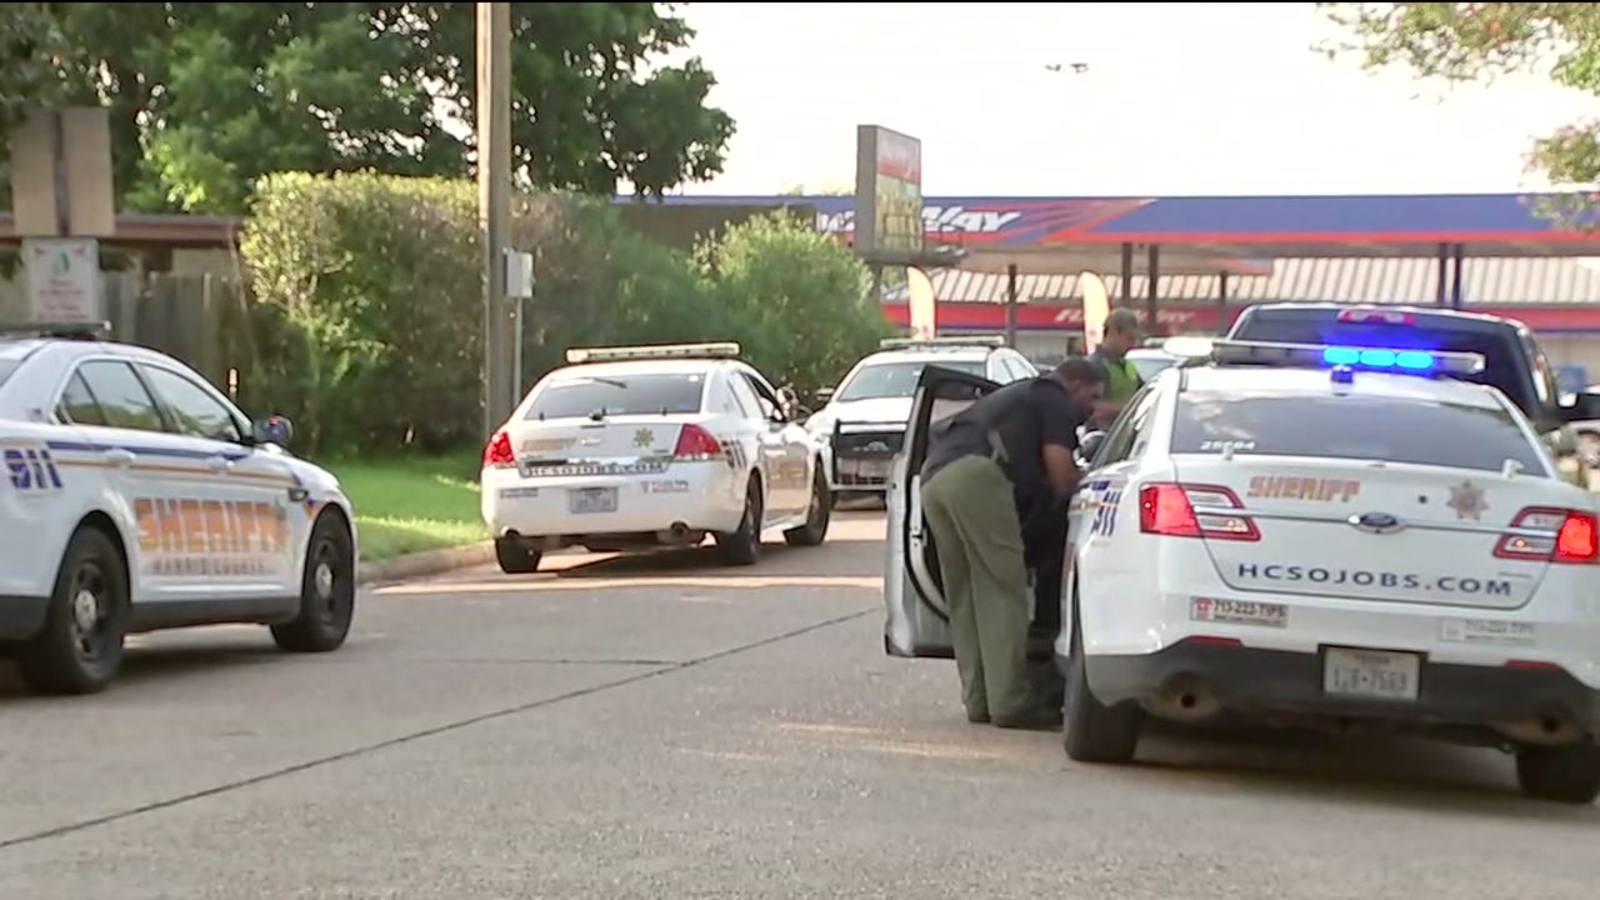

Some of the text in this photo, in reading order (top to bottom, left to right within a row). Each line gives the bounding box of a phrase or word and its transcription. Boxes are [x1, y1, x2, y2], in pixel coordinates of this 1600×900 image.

[5, 449, 63, 489] 911
[1247, 475, 1361, 503] SHERIFF
[133, 498, 288, 552] SHERIFF
[1238, 563, 1511, 596] HCSOJOBS.COM
